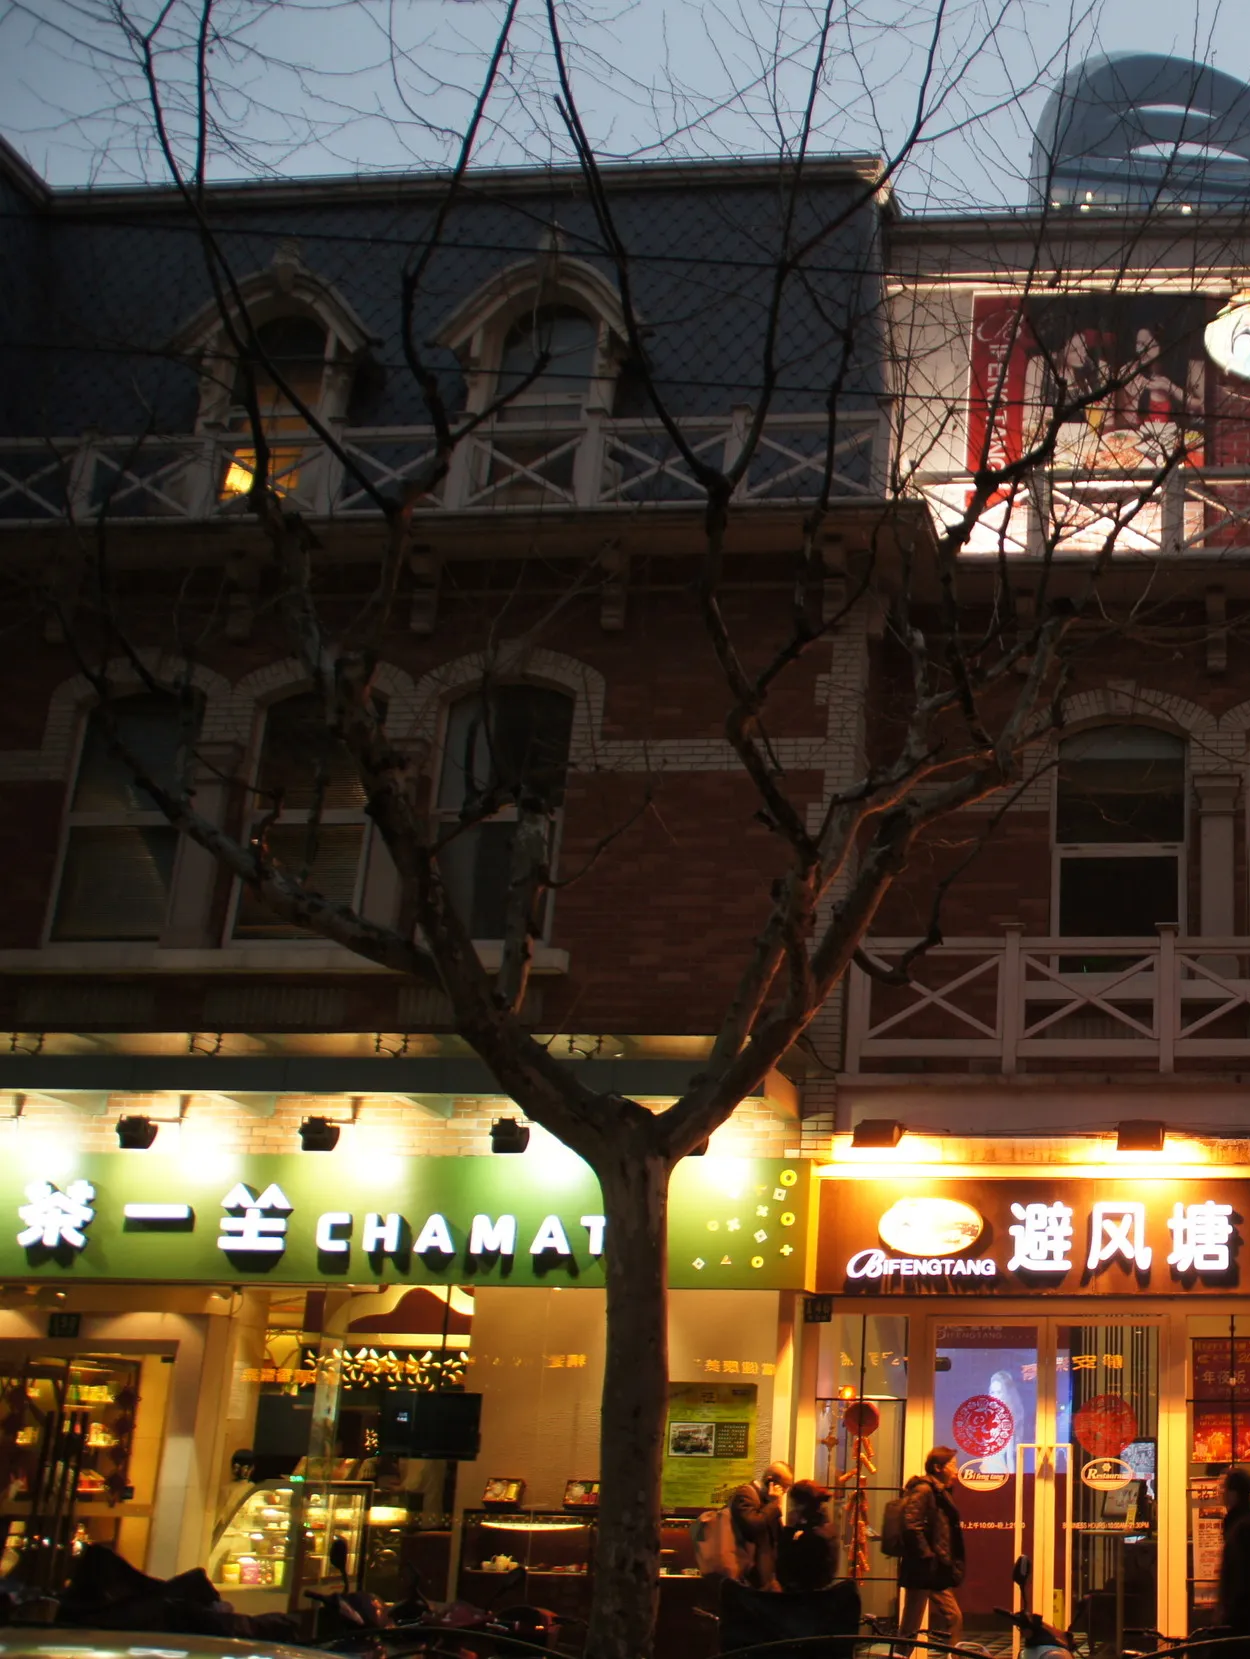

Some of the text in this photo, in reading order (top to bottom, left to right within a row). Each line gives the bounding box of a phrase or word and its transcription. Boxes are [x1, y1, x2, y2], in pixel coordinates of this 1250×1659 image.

[1007, 1201, 1233, 1272] 避风塘
[846, 1248, 996, 1279] BIFENGTANG
